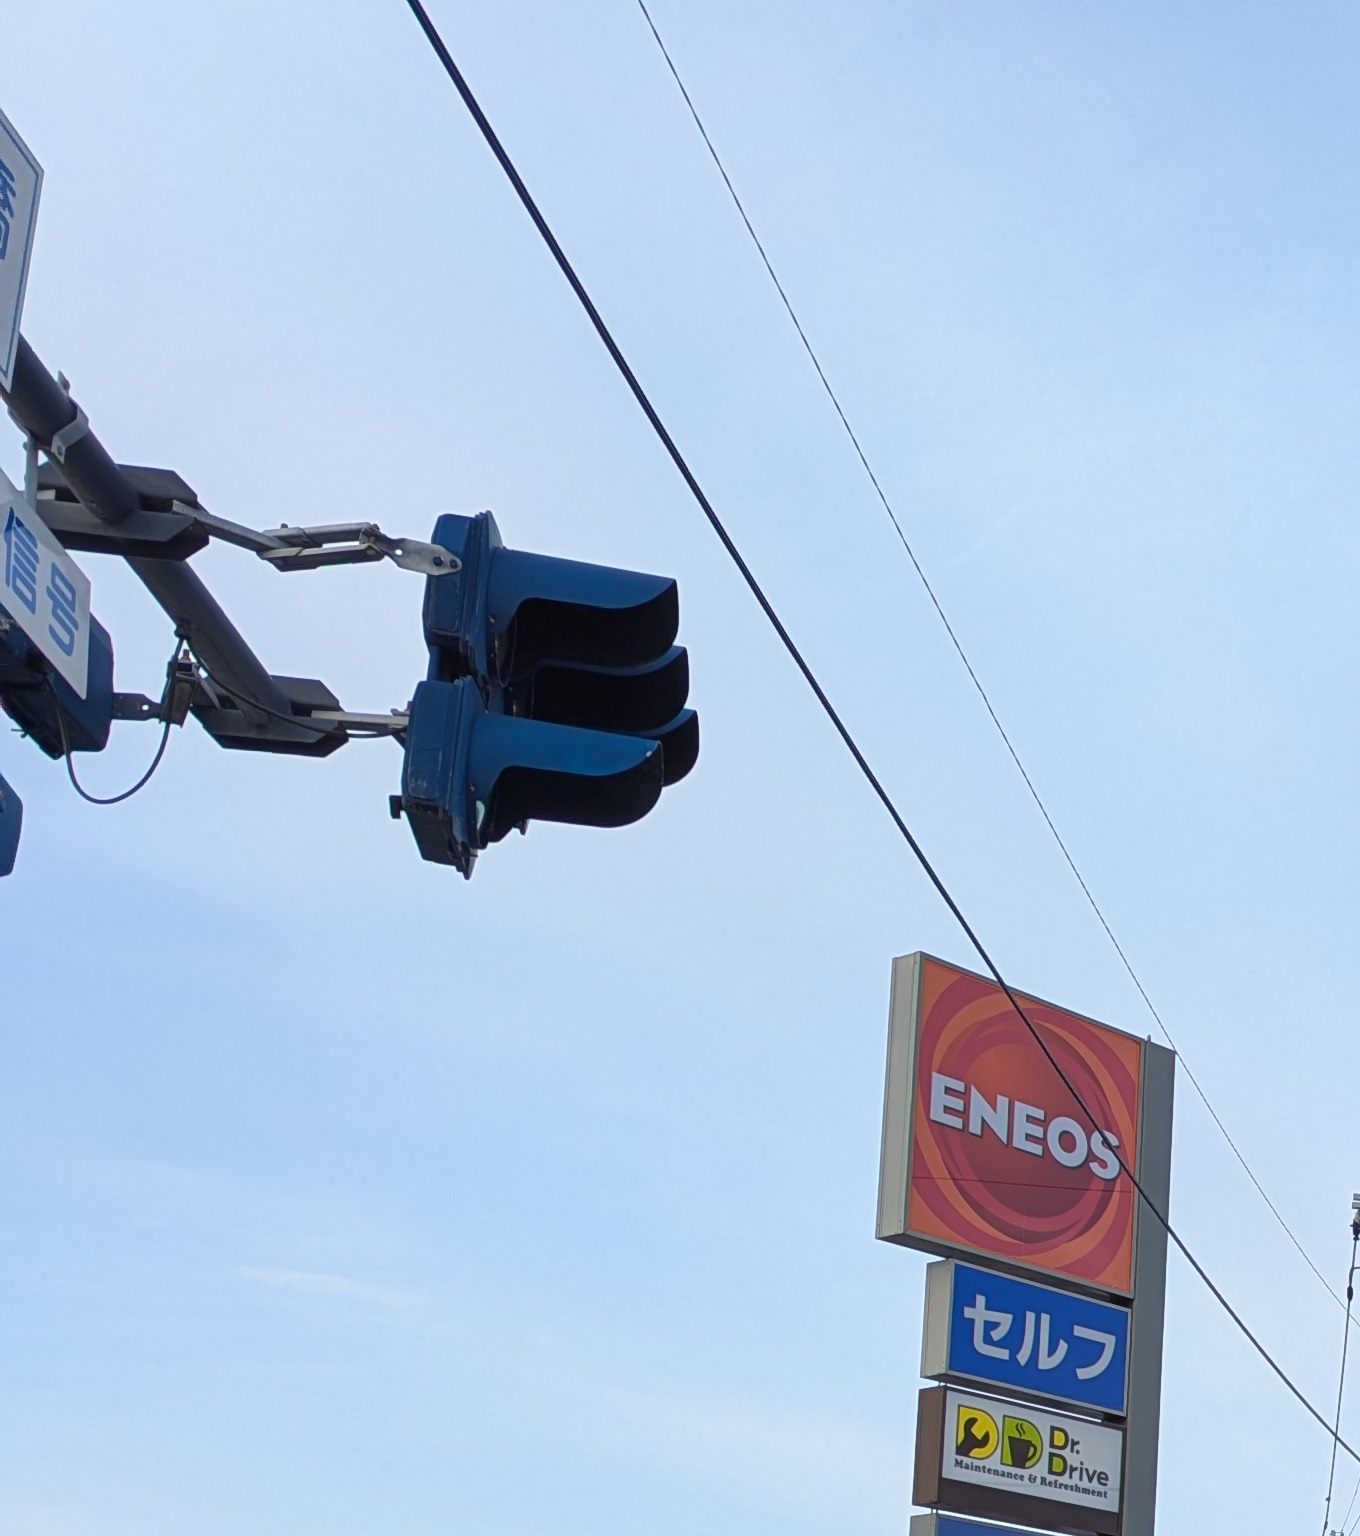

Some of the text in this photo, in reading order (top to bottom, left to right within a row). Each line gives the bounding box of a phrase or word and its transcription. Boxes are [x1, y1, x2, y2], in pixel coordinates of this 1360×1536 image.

[930, 1071, 1122, 1182] ENEOS
[963, 1294, 1116, 1381] セルフ
[1049, 1425, 1081, 1455] Dr.
[954, 1458, 1025, 1482] Maintenance
[1040, 1476, 1109, 1499] Refreshment
[1048, 1451, 1110, 1487] Drive
